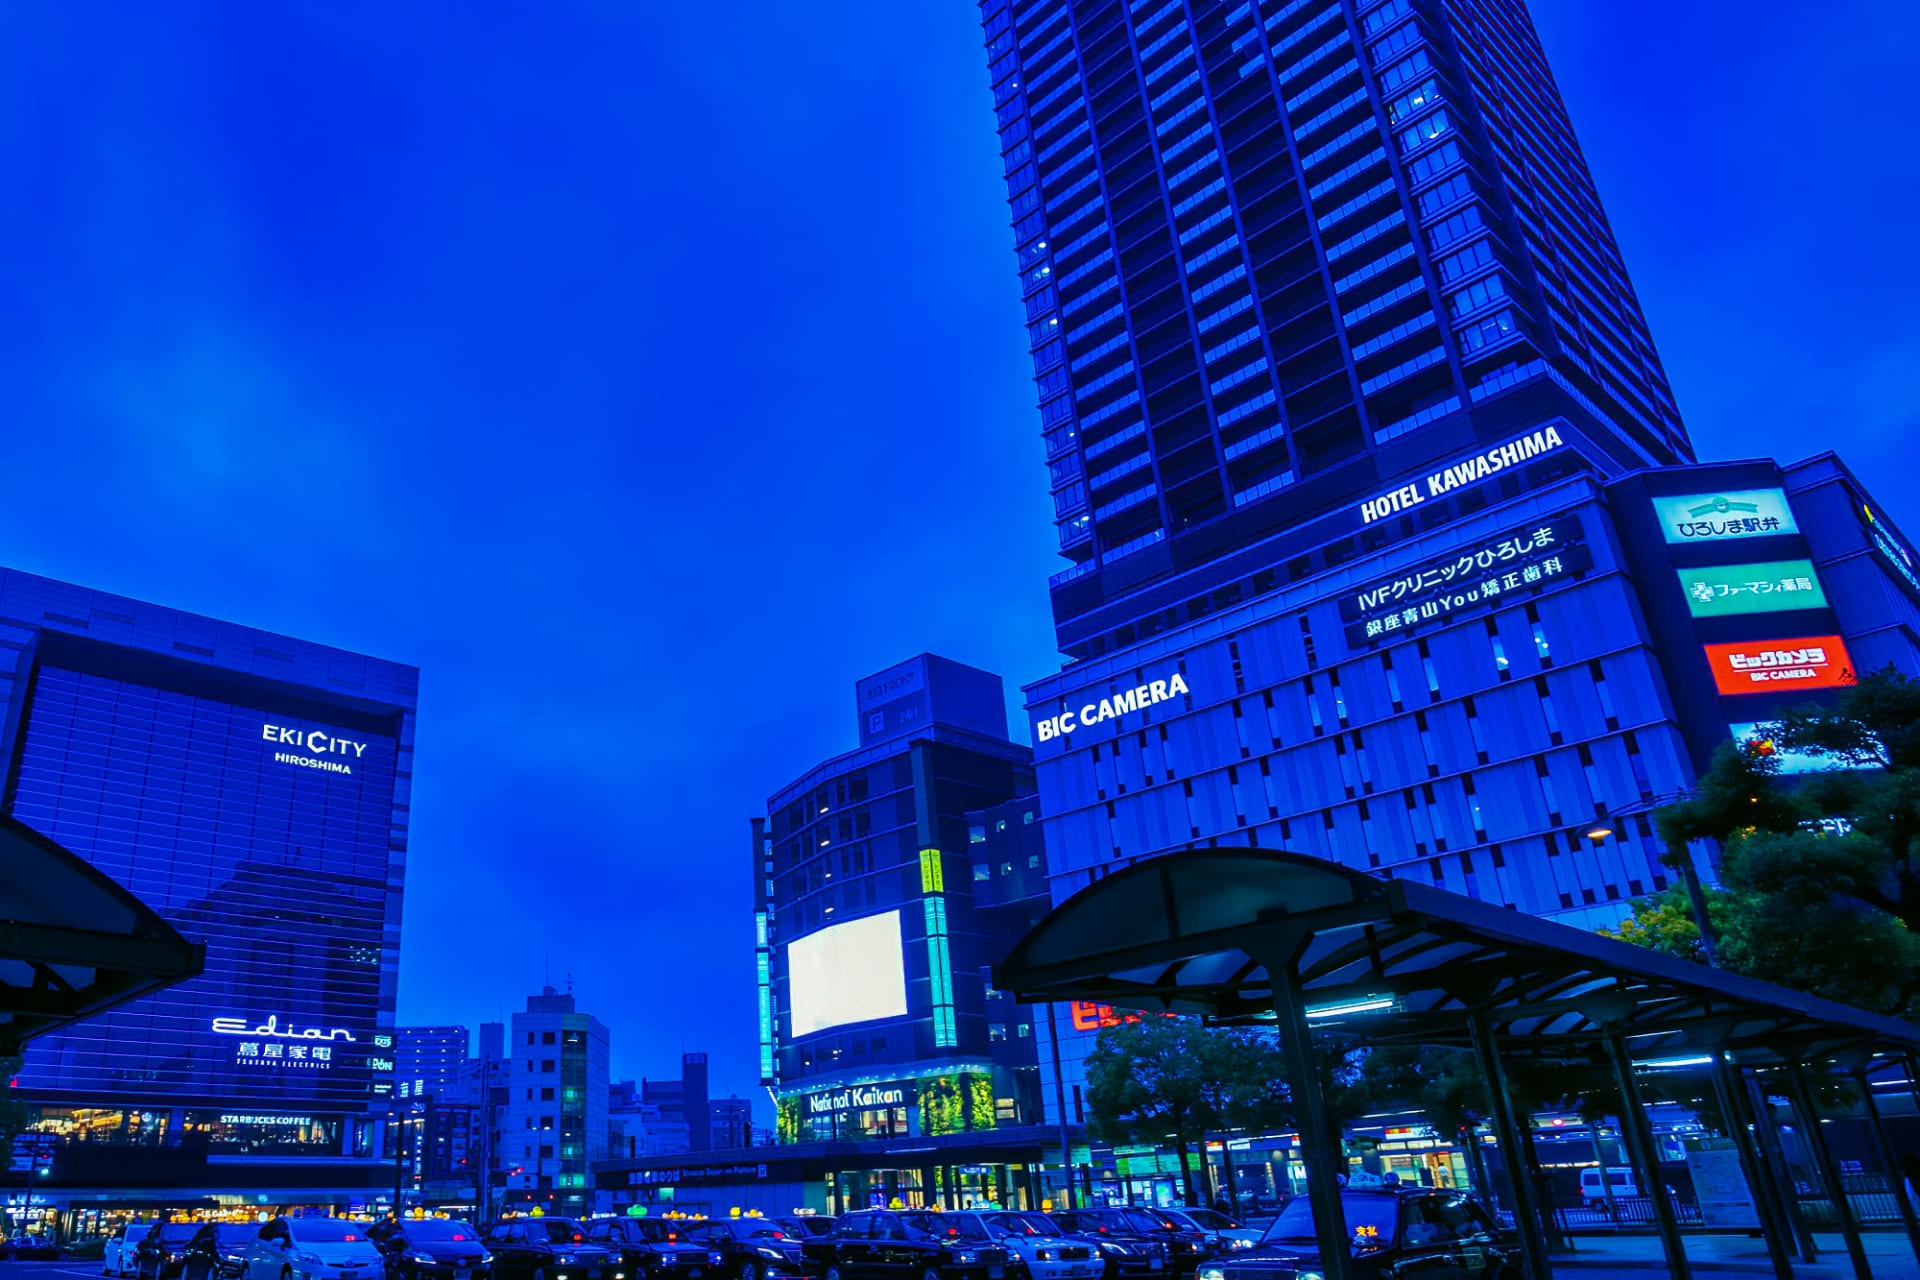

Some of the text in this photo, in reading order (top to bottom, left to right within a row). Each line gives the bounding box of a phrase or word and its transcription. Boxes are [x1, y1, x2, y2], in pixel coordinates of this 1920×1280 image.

[1361, 426, 1563, 524] HOTEL KAWASHIMA
[1677, 516, 1781, 538] ひろしま駅弁
[1358, 527, 1555, 611] IVFクリニックひろしま
[1714, 577, 1813, 597] ファーマシィ薬局
[1729, 648, 1827, 668] ビックカメラ
[1750, 668, 1817, 682] BIC CAMERA
[1037, 673, 1189, 742] BIC CAMERA
[274, 752, 352, 775] HIROSHIMA
[236, 1042, 332, 1061] 蔦屋家電
[282, 1061, 331, 1070] ELECTRICS
[852, 1086, 903, 1107] Kaikan
[220, 1115, 311, 1126] STARBUCKS COFFEE
